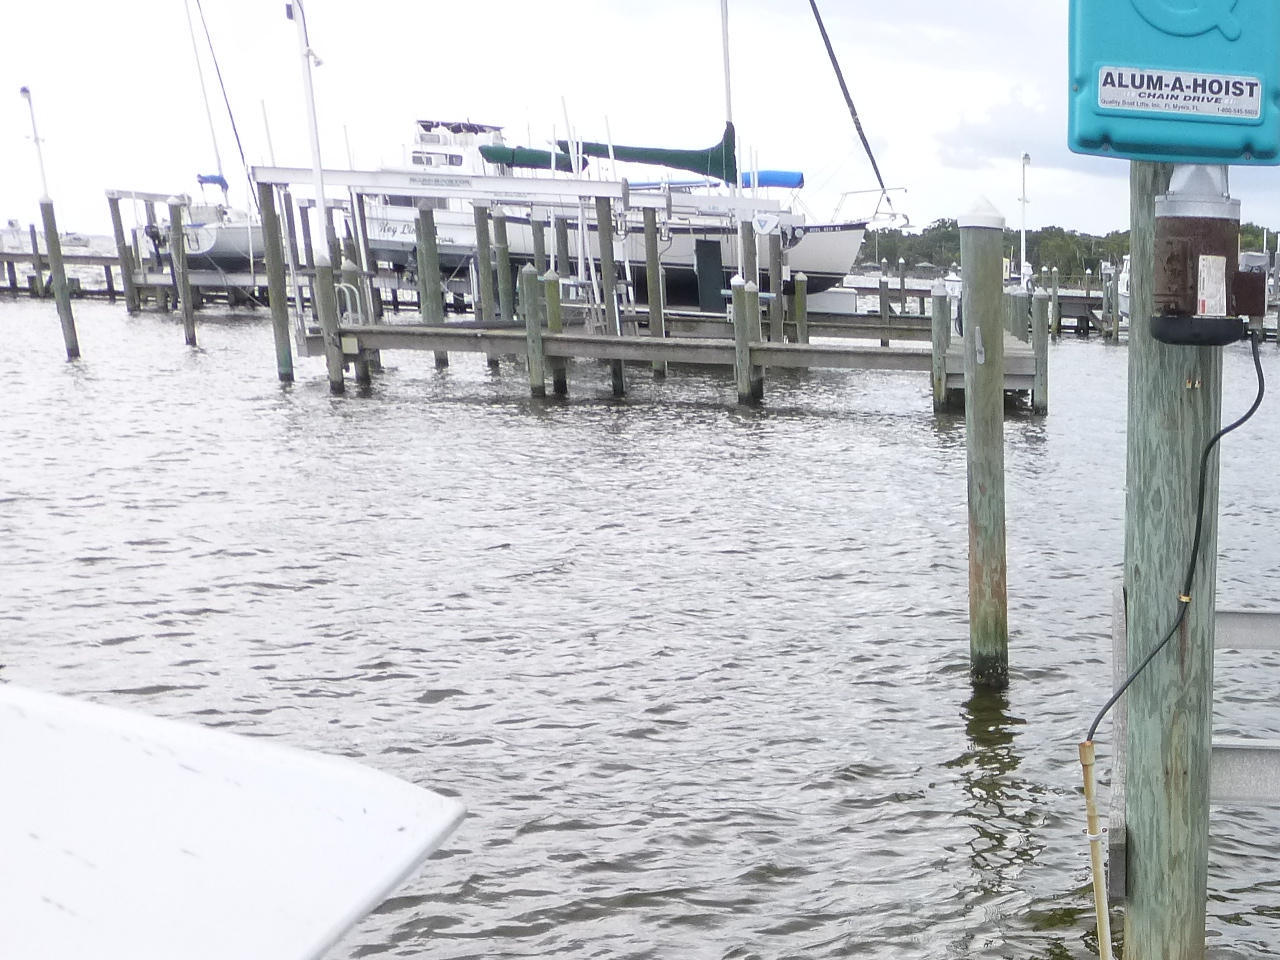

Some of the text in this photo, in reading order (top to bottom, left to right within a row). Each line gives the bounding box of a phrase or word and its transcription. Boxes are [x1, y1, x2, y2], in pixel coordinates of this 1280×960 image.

[1102, 72, 1258, 98] ALUM-A-HOIST
[1138, 92, 1222, 104] CHAIN DRIVE
